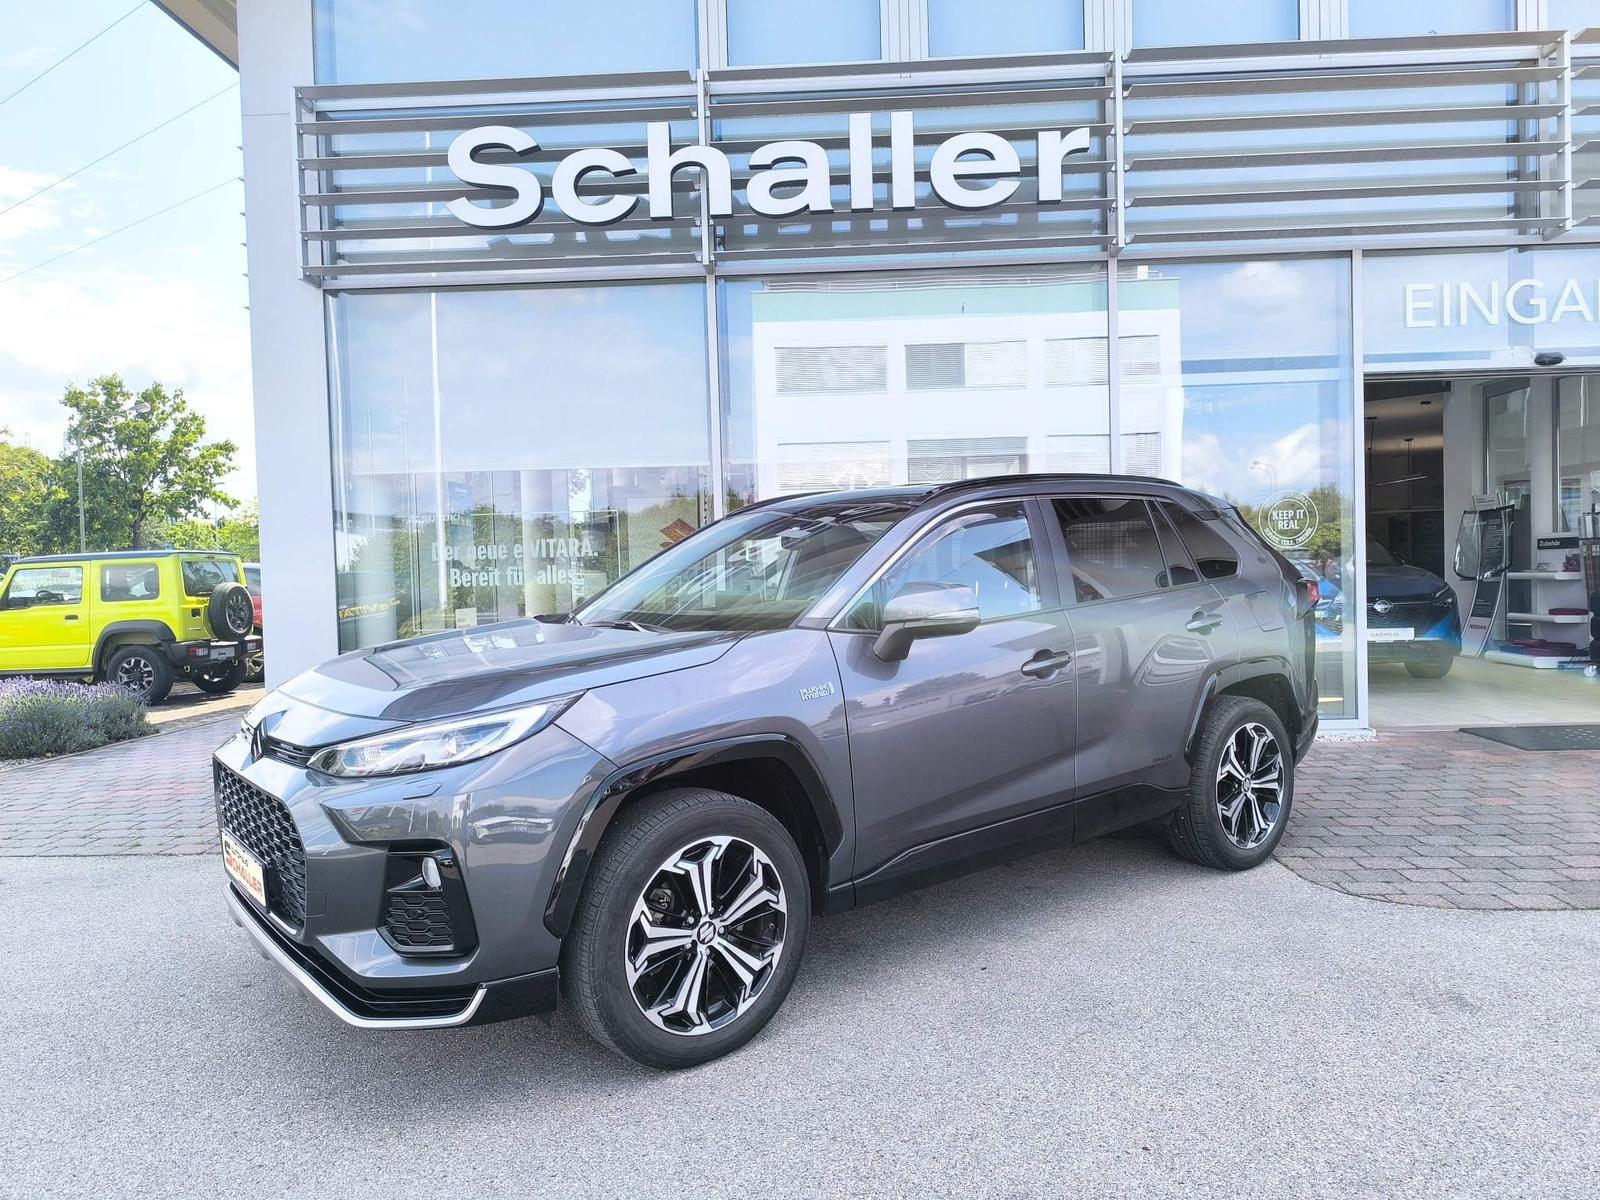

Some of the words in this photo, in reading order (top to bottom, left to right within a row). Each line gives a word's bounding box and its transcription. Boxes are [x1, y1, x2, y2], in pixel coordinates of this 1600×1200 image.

[446, 111, 1090, 228] Schaller
[1405, 277, 1600, 328] EINGA
[1272, 510, 1294, 520] KEEP
[1296, 510, 1304, 519] IT
[1278, 520, 1300, 530] REAL
[529, 537, 599, 558] VITARA.
[450, 568, 500, 588] Bereit
